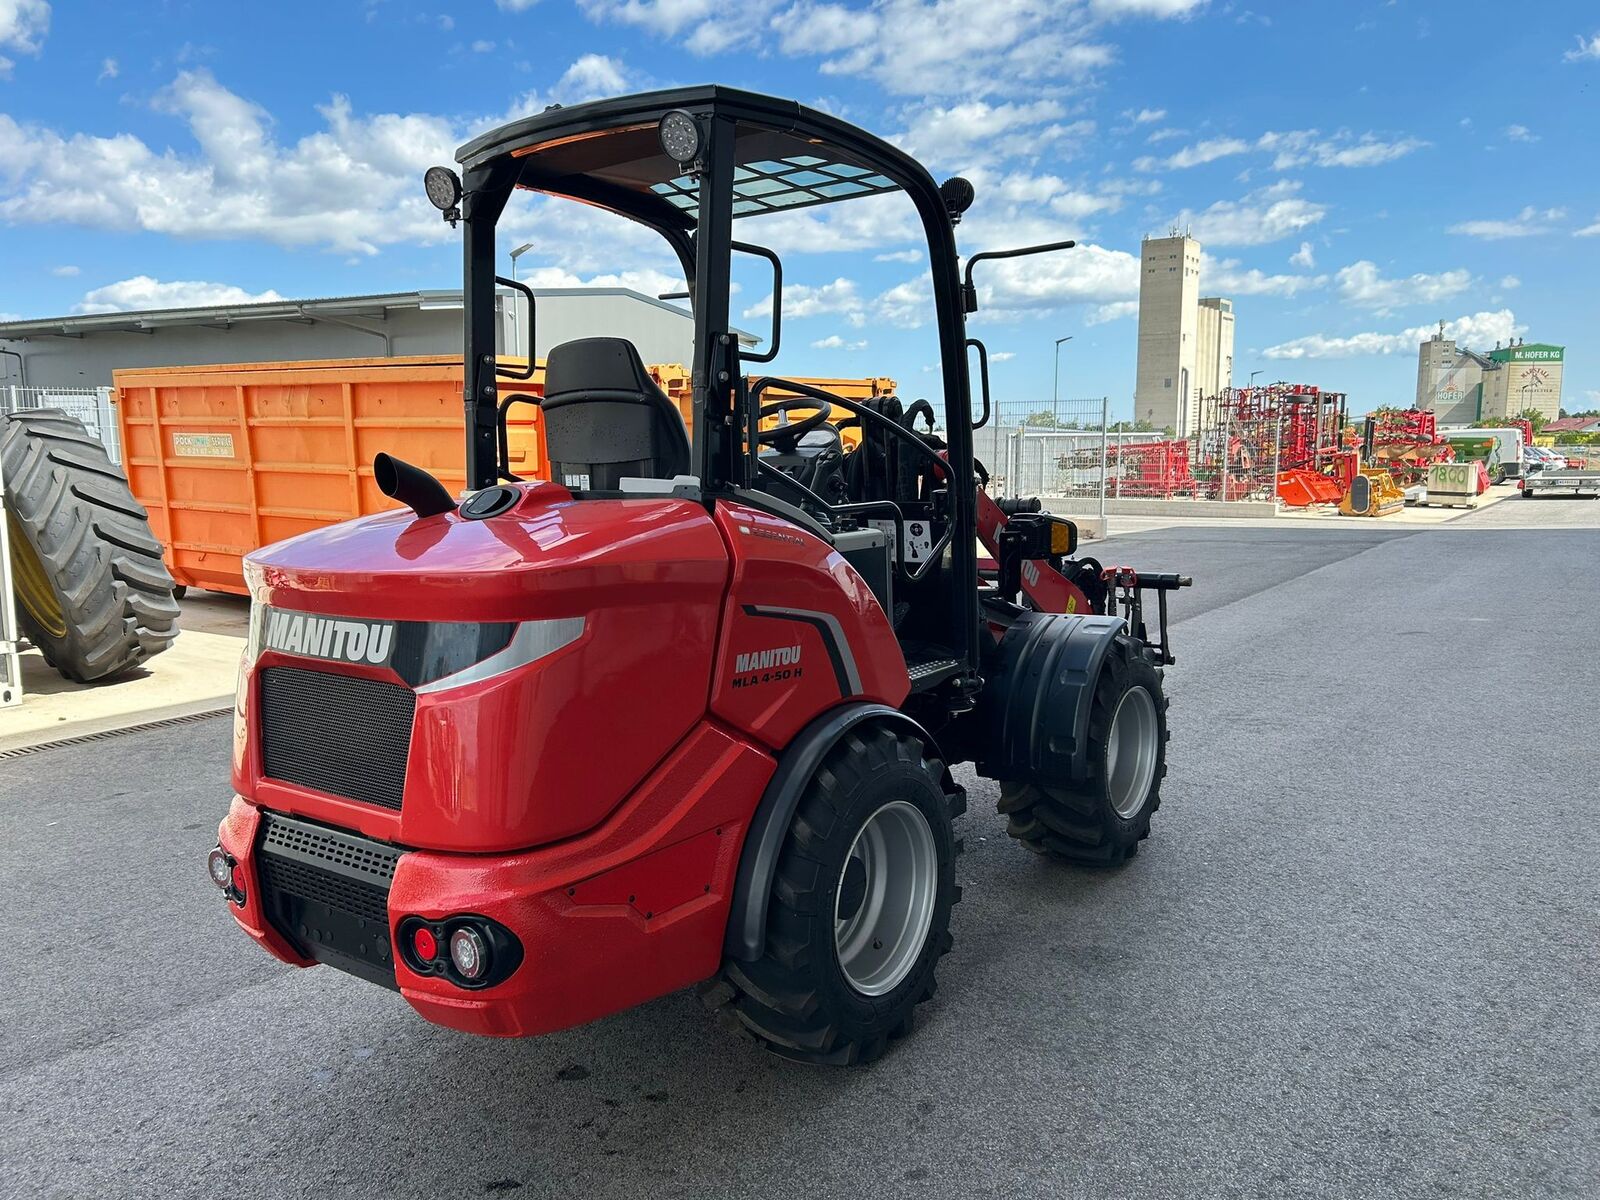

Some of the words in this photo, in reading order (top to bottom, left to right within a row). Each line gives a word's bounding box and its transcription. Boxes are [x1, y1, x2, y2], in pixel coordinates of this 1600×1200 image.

[1550, 350, 1560, 358] KG
[1437, 391, 1463, 400] HOFER
[1430, 465, 1466, 484] 1800
[267, 612, 393, 664] MANITOU
[735, 645, 801, 673] MANITOU
[732, 676, 759, 689] MLA
[762, 669, 791, 683] 4-50
[794, 667, 803, 678] H
